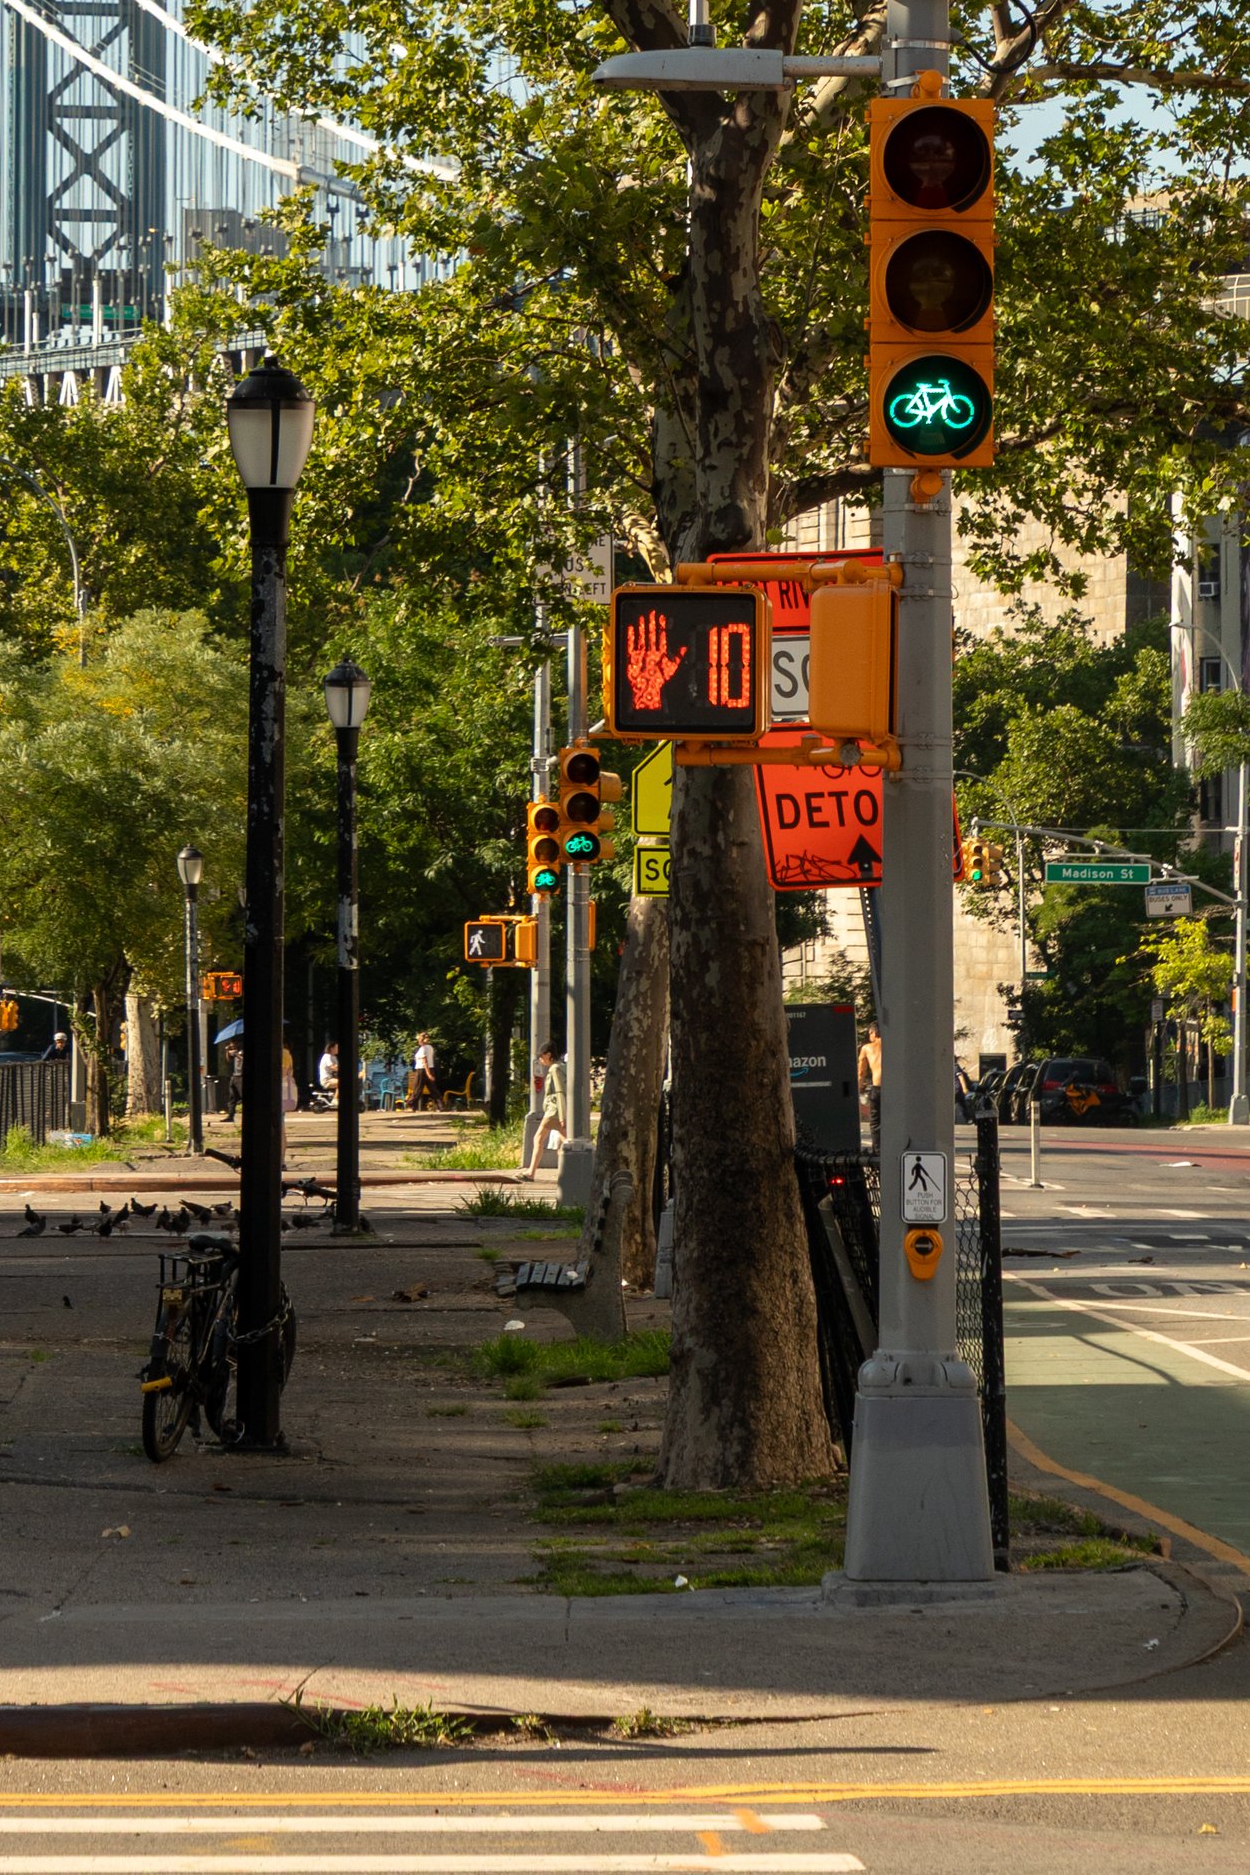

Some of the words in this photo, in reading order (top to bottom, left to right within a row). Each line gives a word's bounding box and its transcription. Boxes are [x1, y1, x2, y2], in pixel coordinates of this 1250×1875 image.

[778, 580, 810, 610] RIV
[708, 623, 751, 708] 10
[775, 789, 879, 830] DETO
[1062, 868, 1114, 879] Madison
[1120, 867, 1134, 879] St
[789, 1056, 827, 1068] azon
